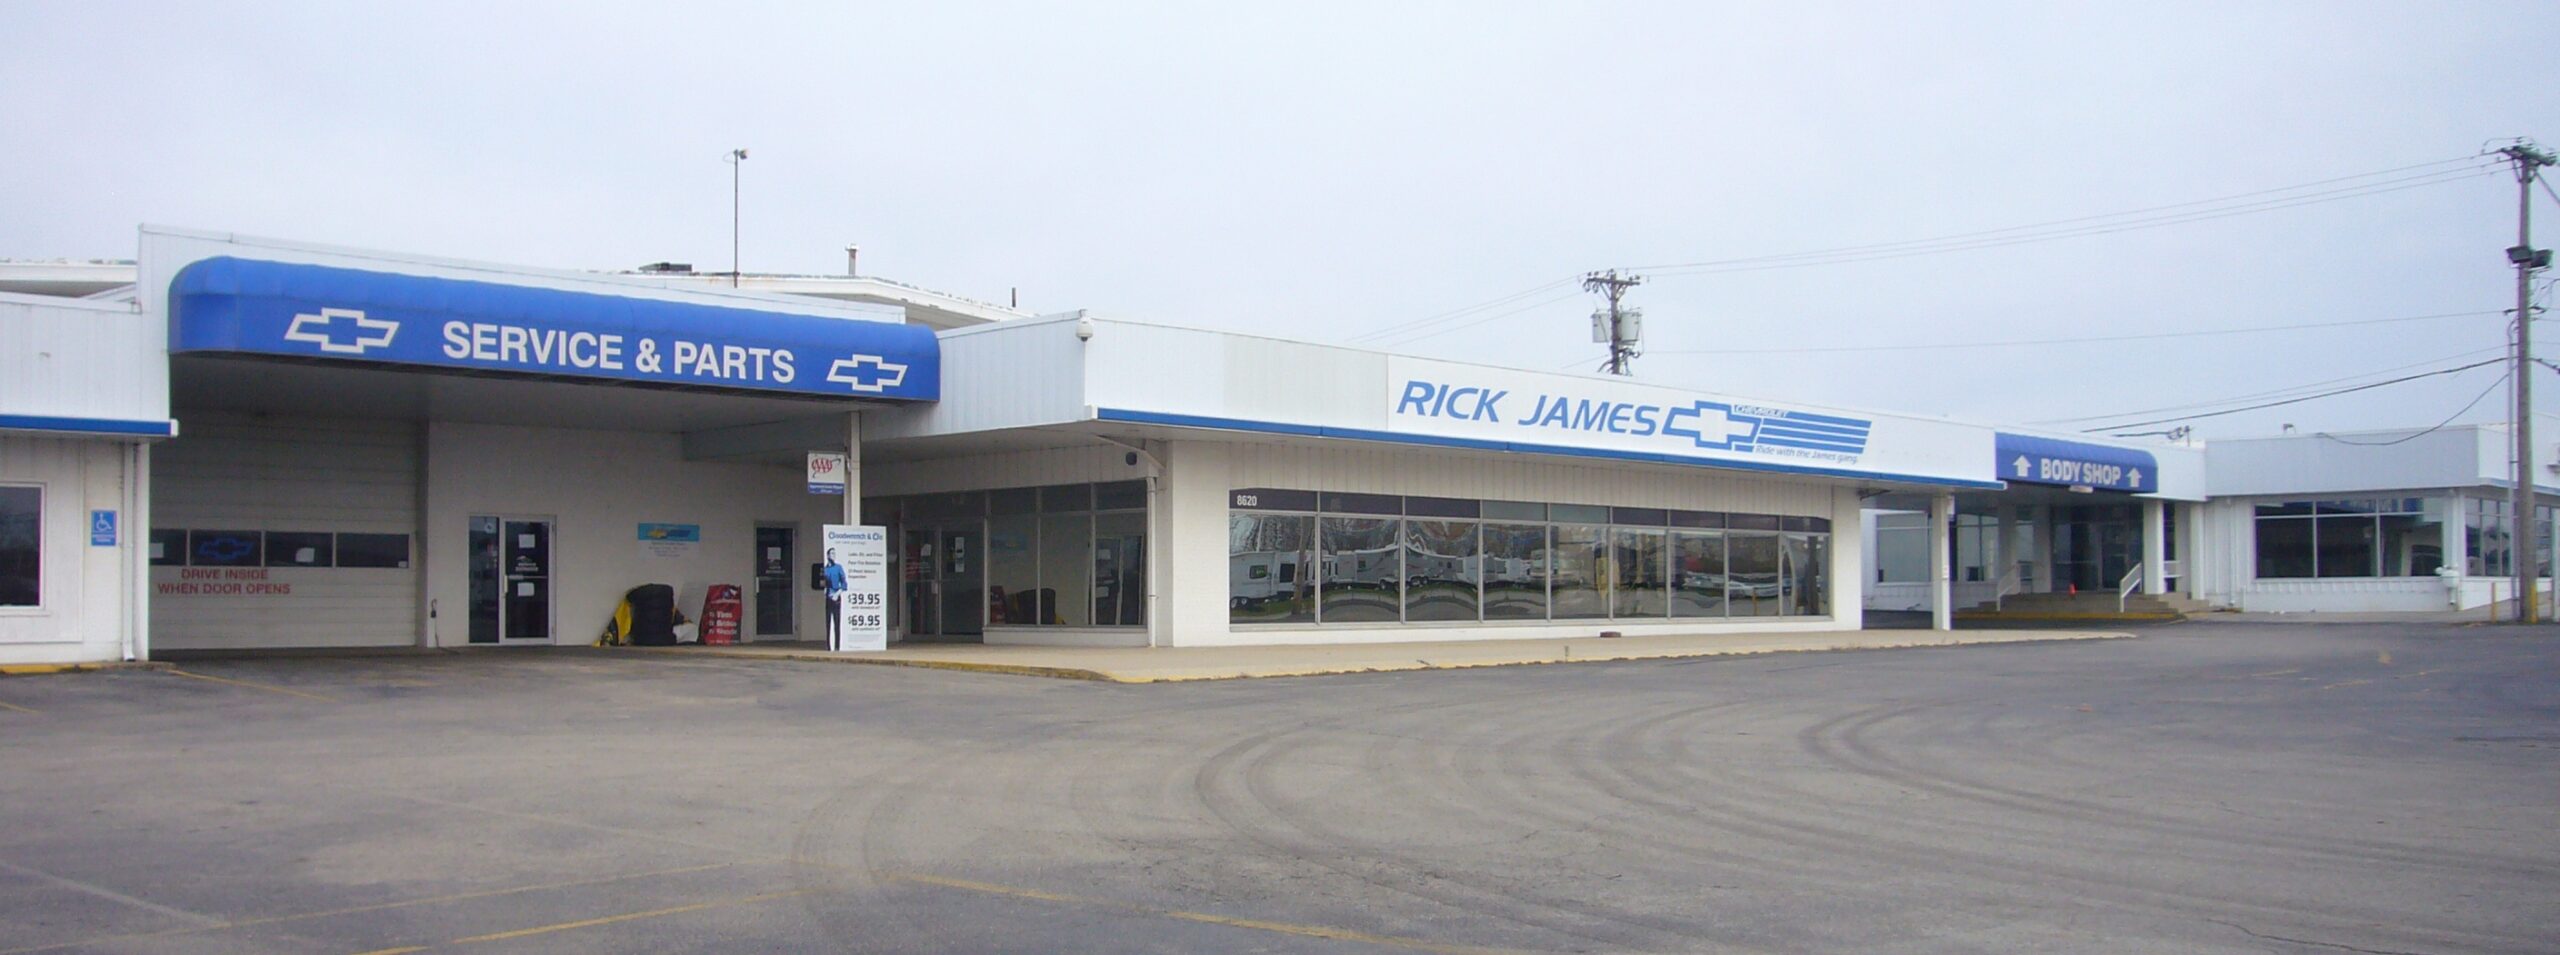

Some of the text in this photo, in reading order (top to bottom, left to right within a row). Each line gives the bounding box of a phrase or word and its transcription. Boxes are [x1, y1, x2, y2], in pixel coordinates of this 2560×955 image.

[442, 320, 796, 384] SERVICE & PARTS
[1396, 380, 1660, 436] RICK JAMES
[1755, 445, 1775, 455] Ride
[1776, 447, 1795, 457] with
[1796, 449, 1809, 458] the
[1811, 451, 1836, 461] James
[2040, 457, 2121, 486] BODY SHOP
[1237, 494, 1257, 506] 8620
[181, 568, 268, 579] DRIVE INSIDE
[158, 583, 290, 594] WHEN DOOR OPENS
[848, 593, 880, 605] $39.95
[848, 614, 880, 626] $69.95
